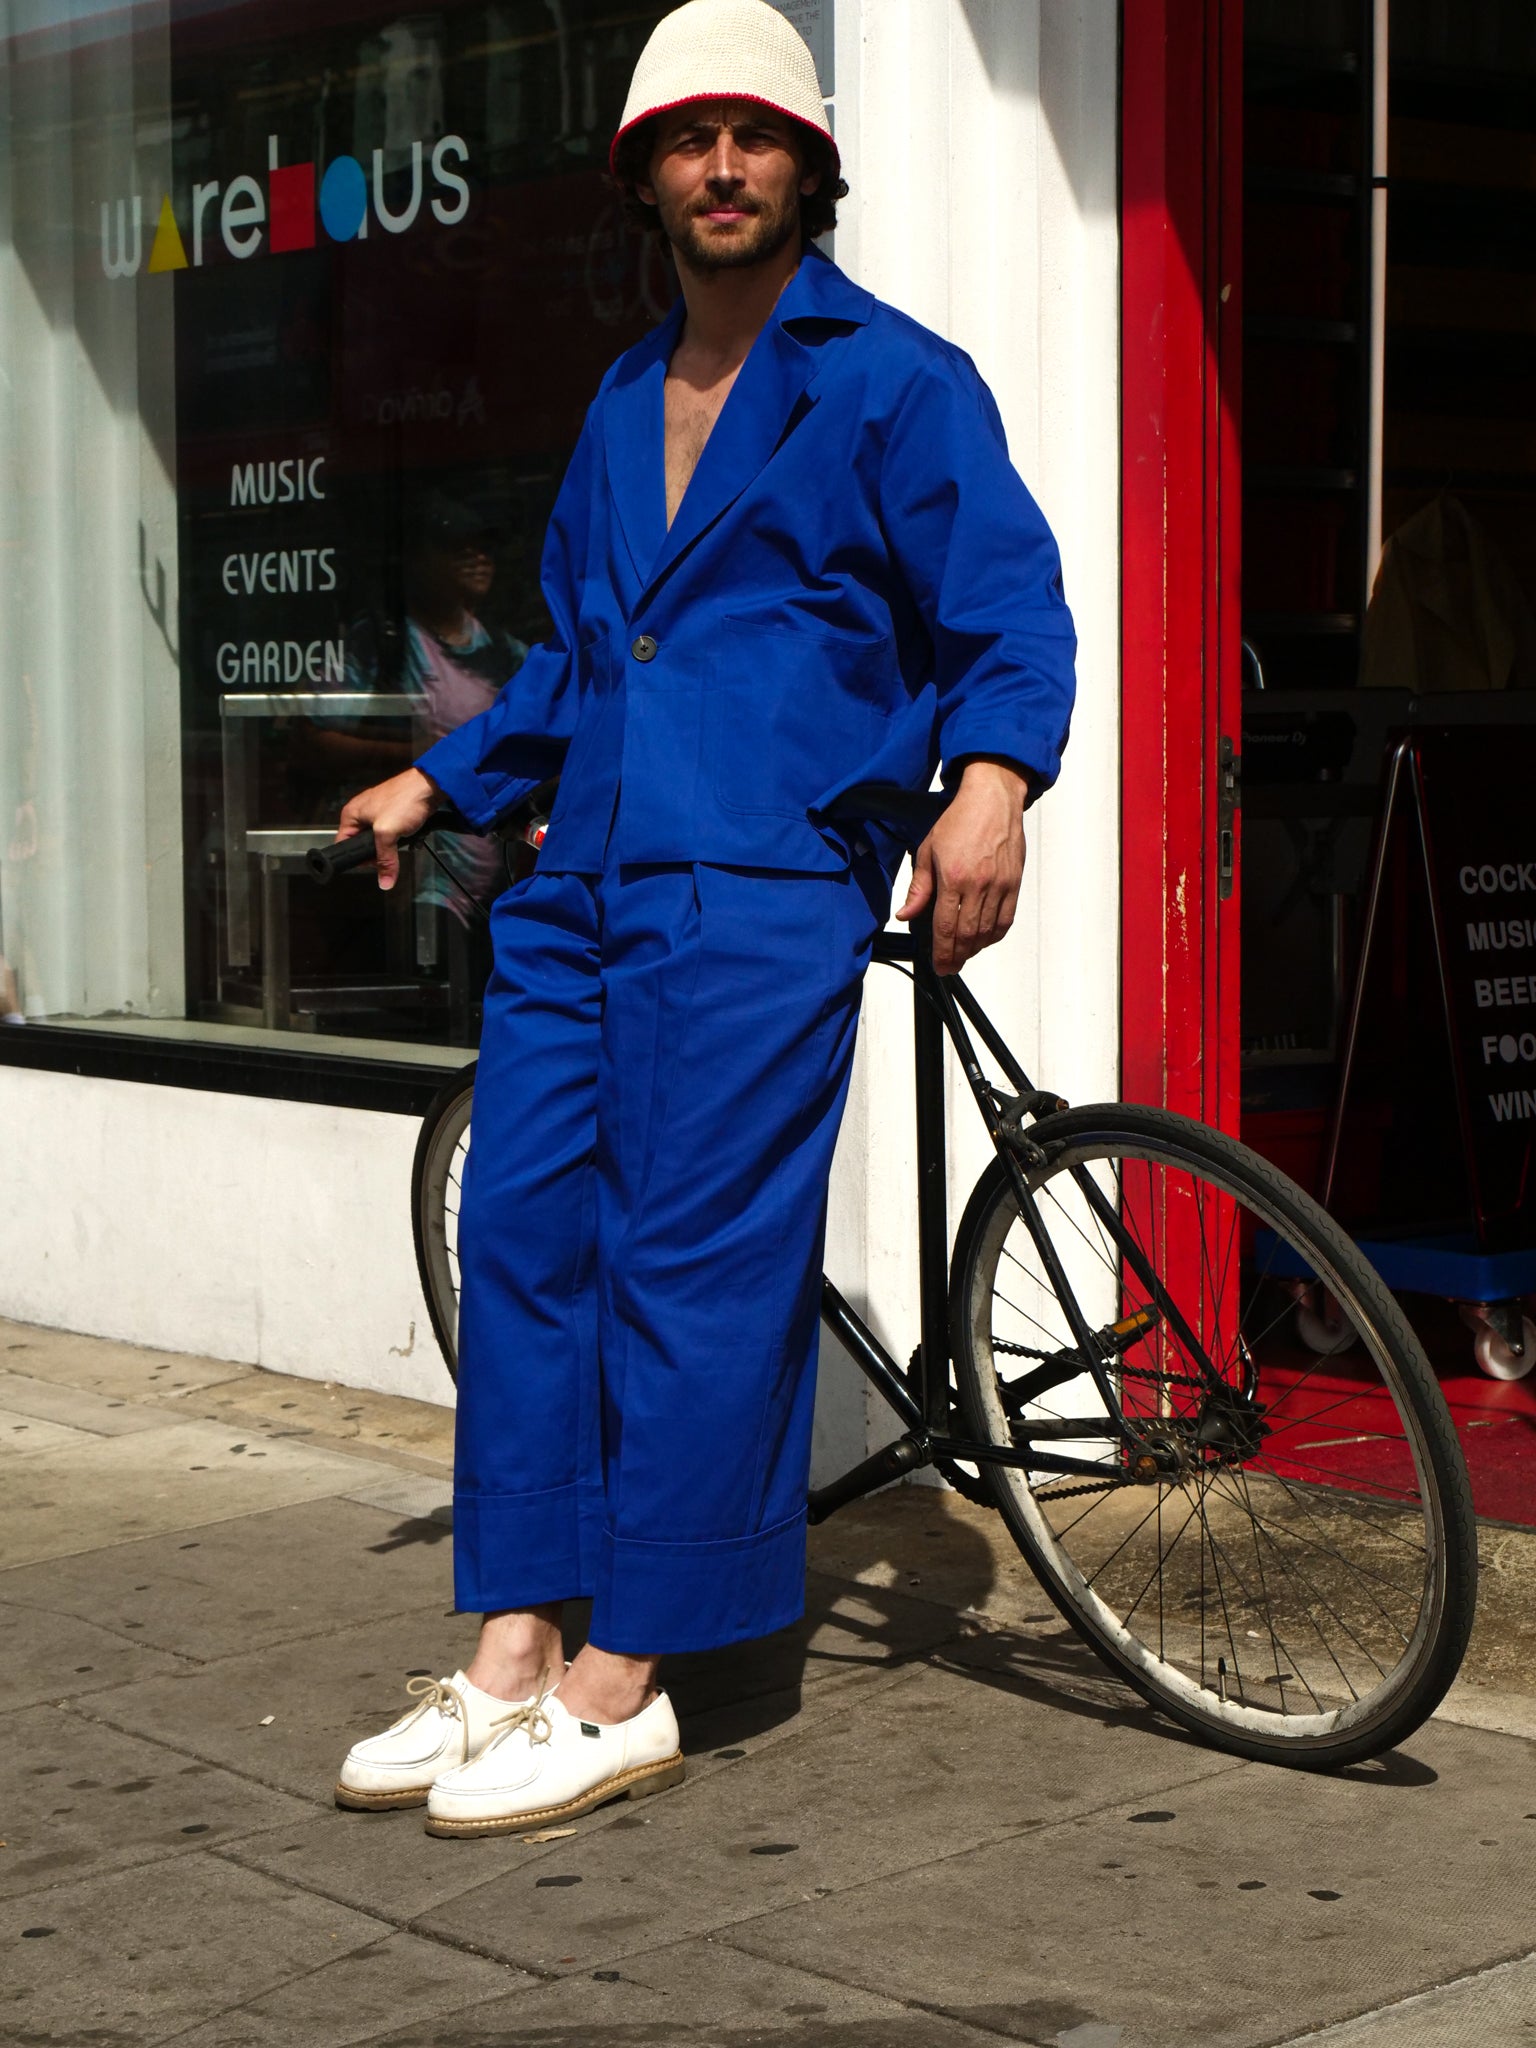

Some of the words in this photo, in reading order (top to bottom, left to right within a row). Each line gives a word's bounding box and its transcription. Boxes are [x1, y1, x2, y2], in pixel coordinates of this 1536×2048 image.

[230, 457, 325, 506] MUSIC
[222, 548, 337, 595] EVENTS
[216, 639, 345, 684] GARDEN
[1458, 863, 1536, 895] COCK
[1465, 919, 1536, 951] MUSI
[1487, 1088, 1536, 1123] WIN
